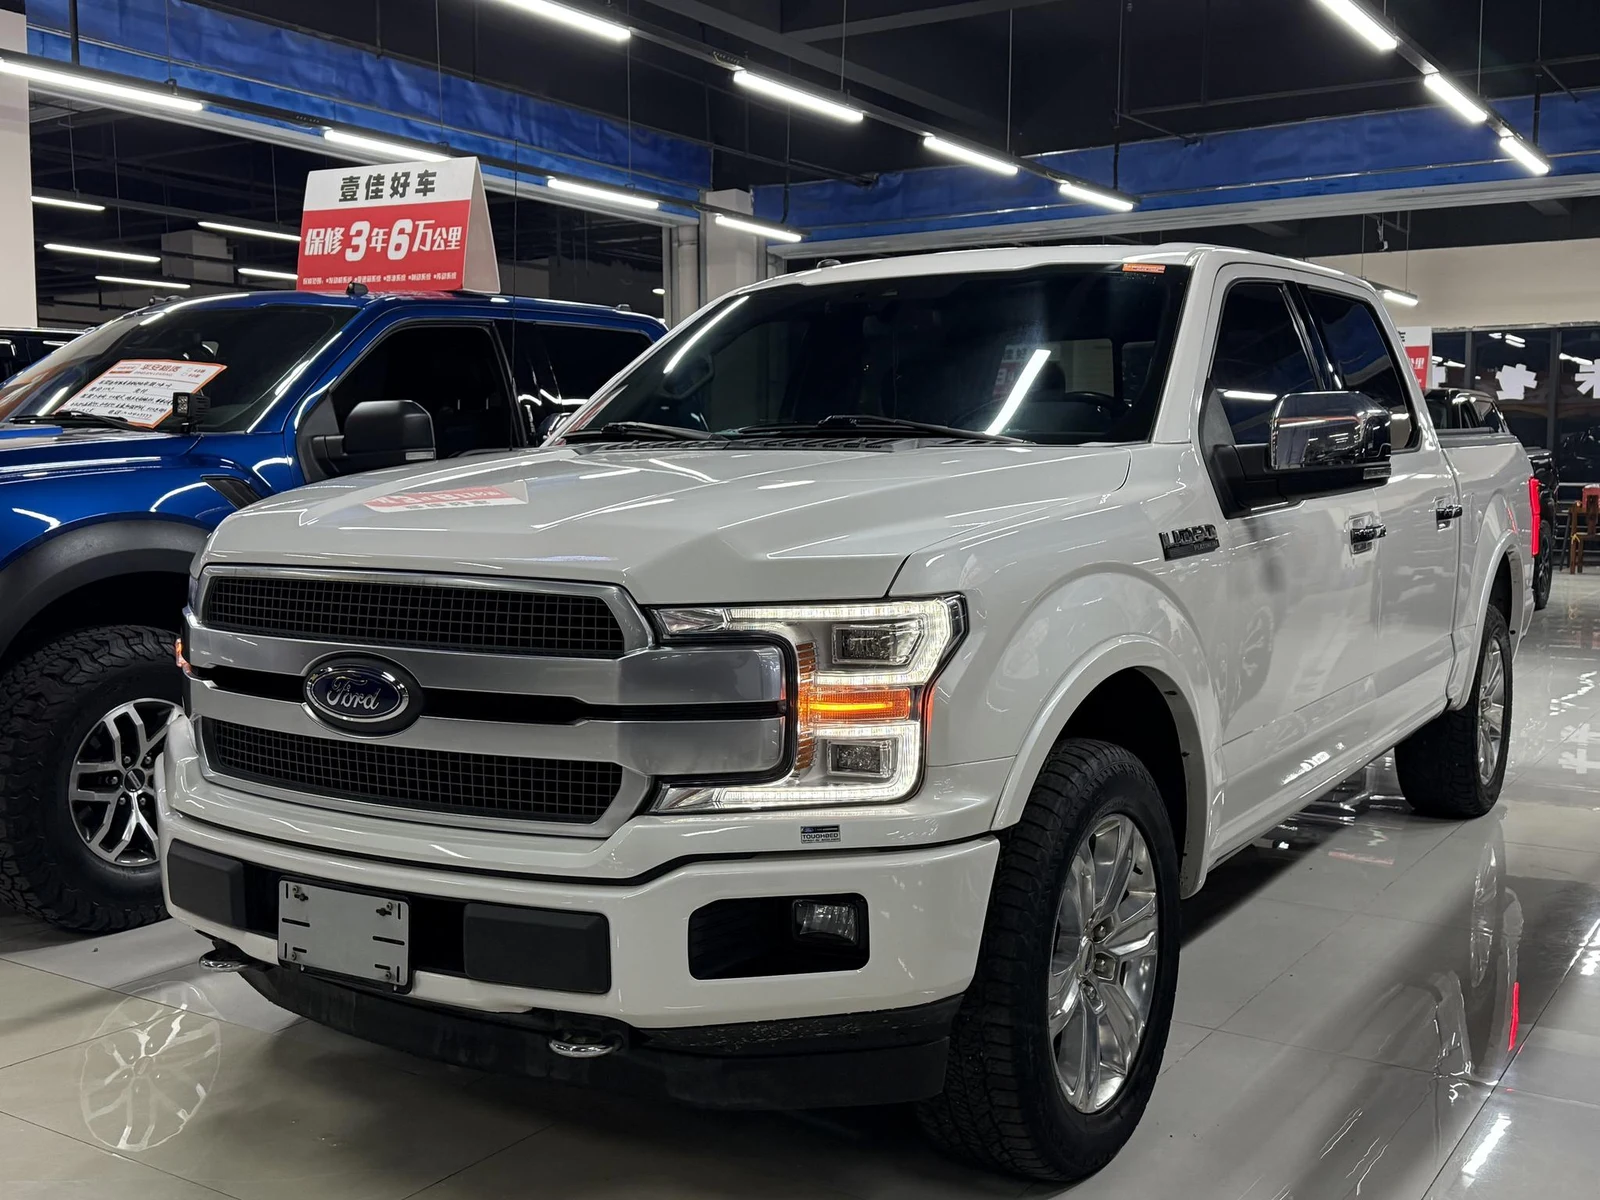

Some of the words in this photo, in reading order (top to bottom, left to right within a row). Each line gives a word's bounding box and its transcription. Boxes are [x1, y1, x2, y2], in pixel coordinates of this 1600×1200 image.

[338, 169, 437, 202] 壹佳好车
[304, 219, 462, 261] 保修3年6万公里
[326, 676, 381, 710] Ford
